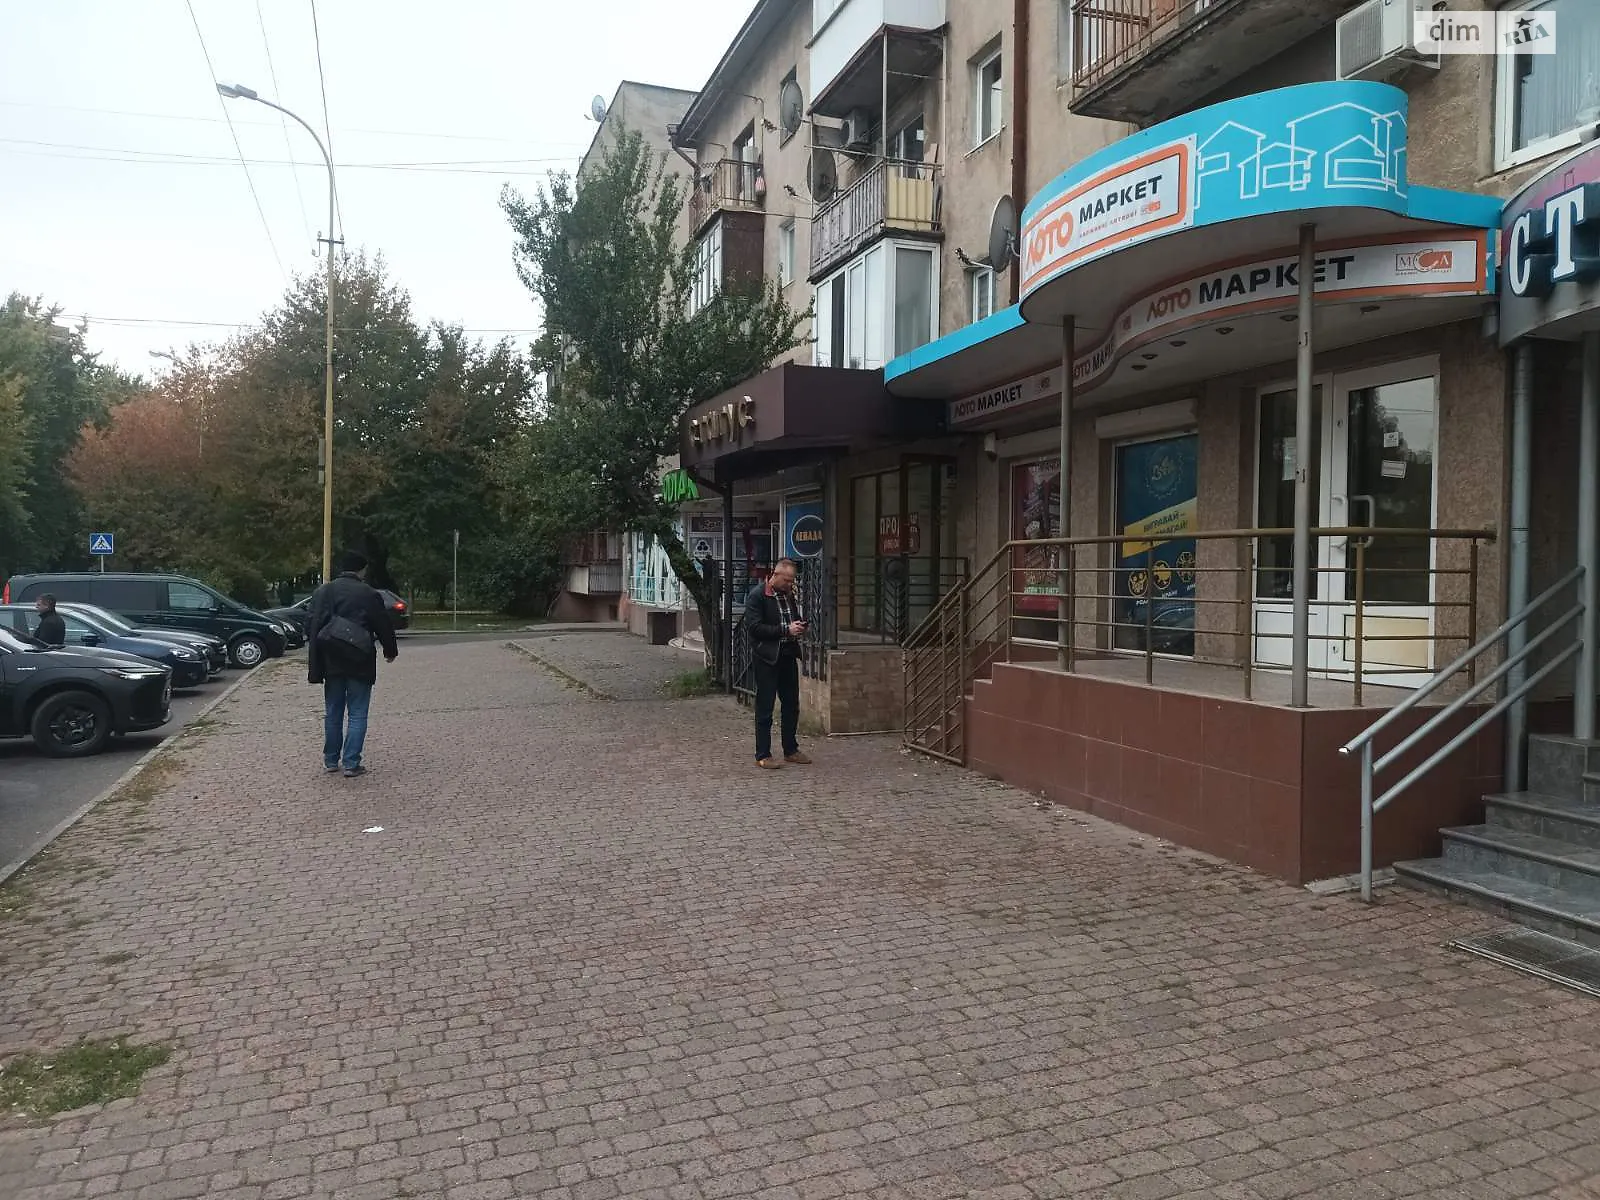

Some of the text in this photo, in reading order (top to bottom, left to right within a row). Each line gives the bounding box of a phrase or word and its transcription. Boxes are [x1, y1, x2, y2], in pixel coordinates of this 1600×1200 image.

[1026, 175, 1162, 270] ЛОТО МАРКЕТ
[1509, 185, 1600, 295] СТ
[1147, 256, 1354, 322] ЛОТО МАРКЕТ
[954, 400, 976, 418] ЛОТО
[978, 384, 1022, 411] МАРКЕТ
[1074, 359, 1090, 378] ОТО
